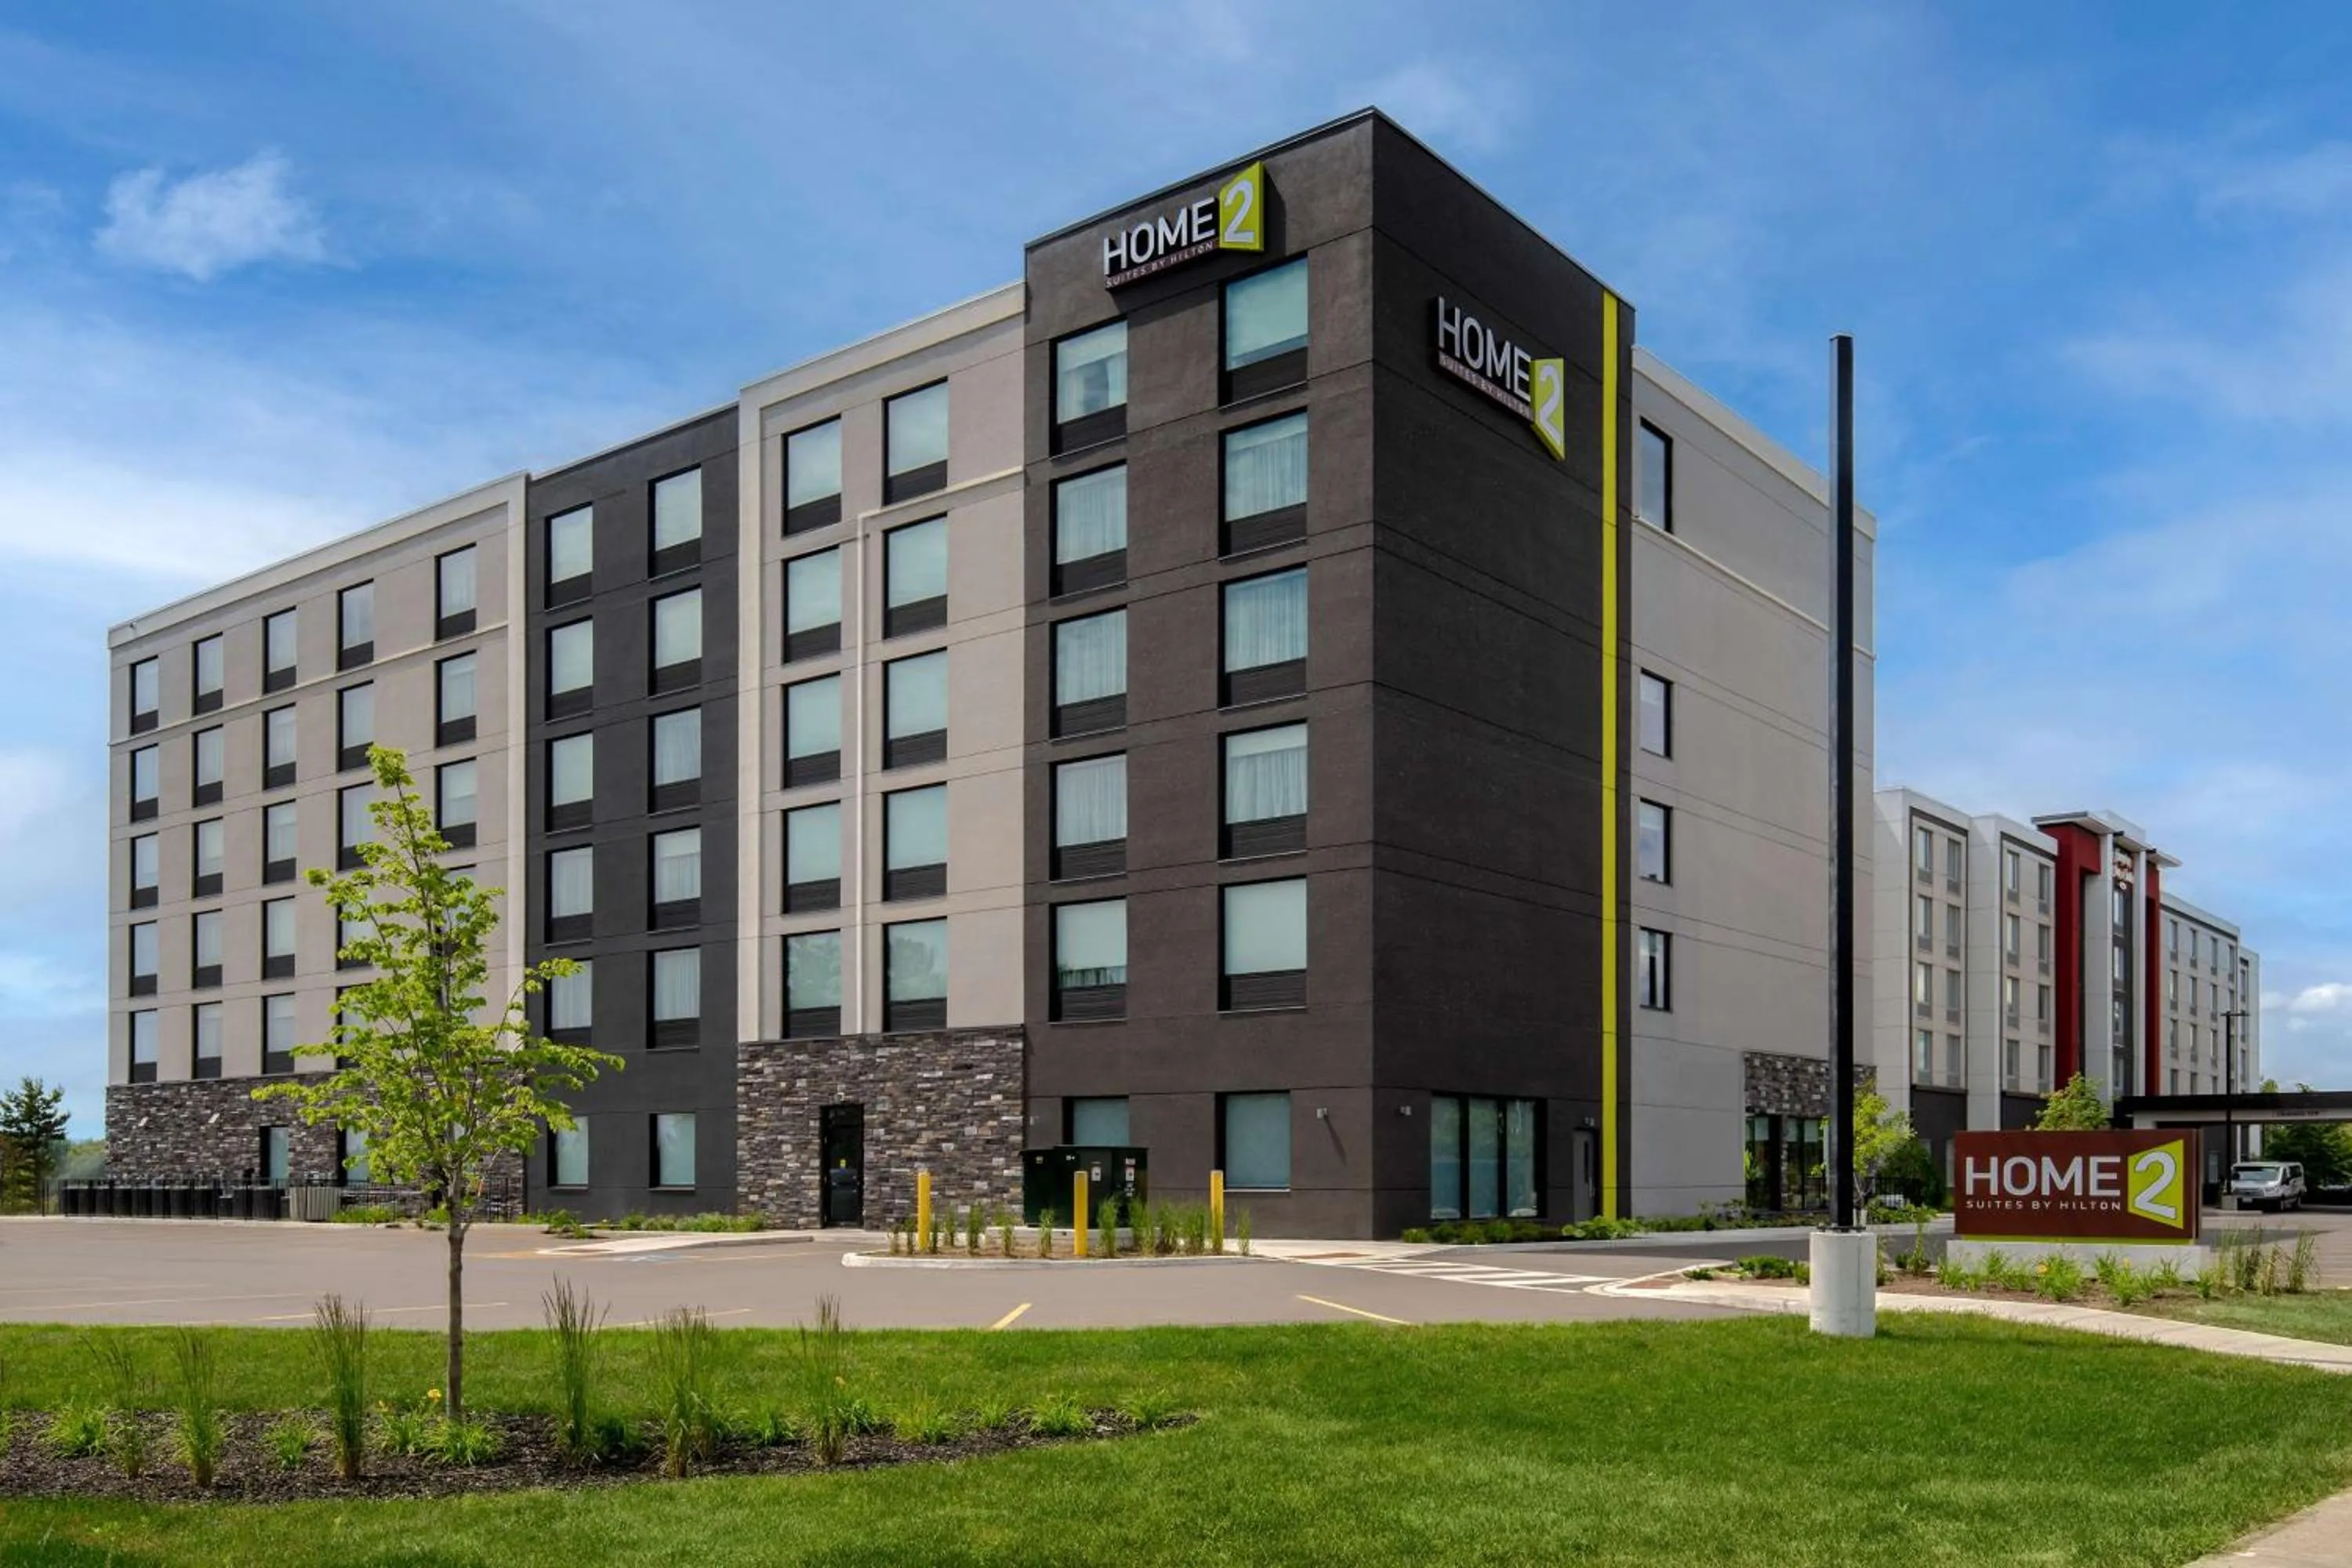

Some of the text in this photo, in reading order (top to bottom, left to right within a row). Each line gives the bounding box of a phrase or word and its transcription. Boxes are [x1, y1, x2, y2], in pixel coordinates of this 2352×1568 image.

[1103, 179, 1255, 275] HOME 2
[1105, 240, 1214, 289] SUITES BY HILTON
[1438, 296, 1562, 447] HOME 2
[1965, 1150, 2176, 1219] HOME 2
[1965, 1200, 2122, 1211] SUITES BY HILTON
